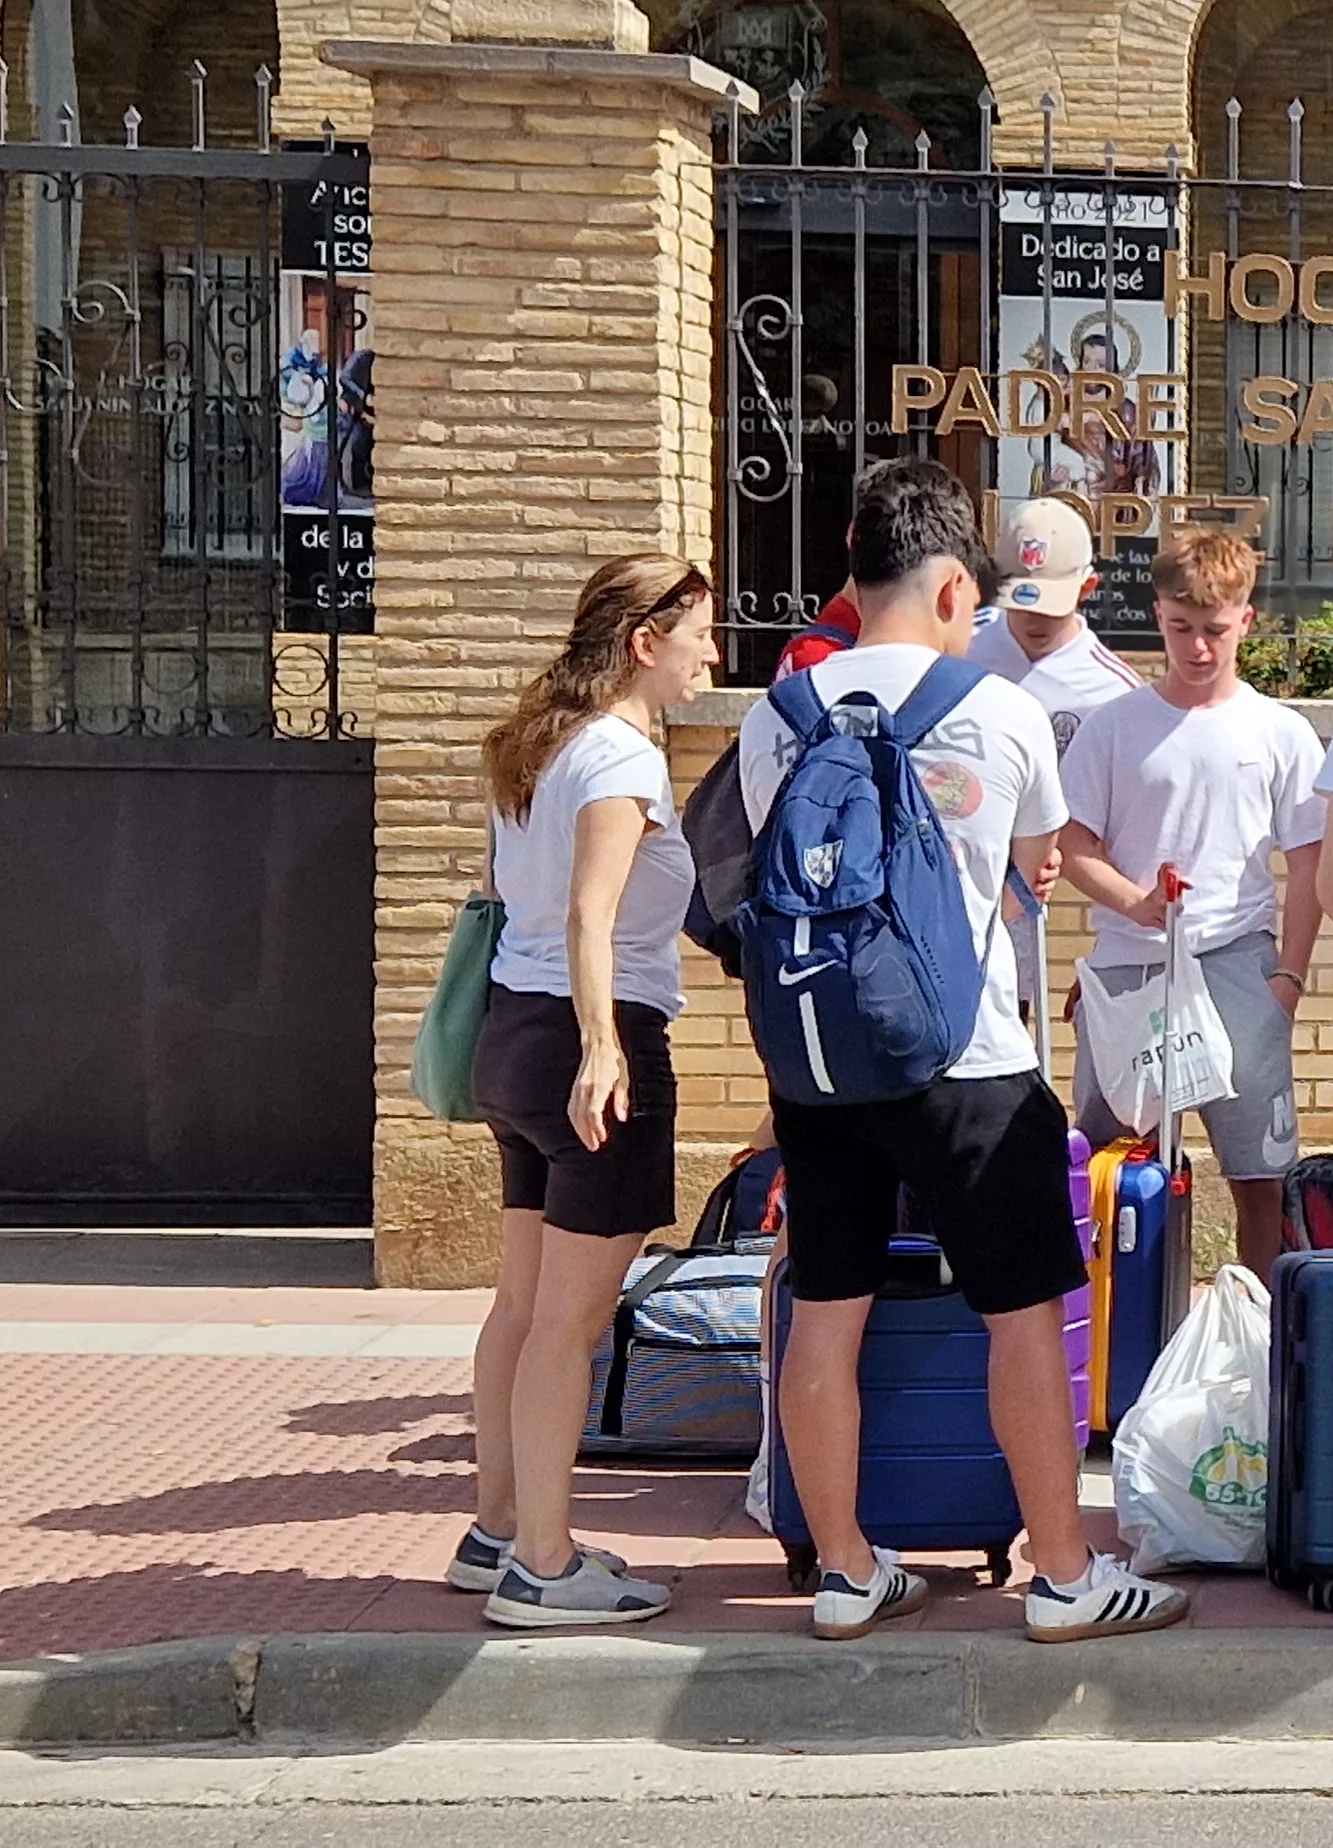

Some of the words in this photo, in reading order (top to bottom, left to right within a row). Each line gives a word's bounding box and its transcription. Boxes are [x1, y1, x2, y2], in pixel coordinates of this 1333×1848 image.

[1146, 243, 1161, 263] a
[1036, 264, 1082, 289] San
[1087, 265, 1145, 291] José
[890, 363, 1189, 441] PADRE
[342, 524, 364, 549] la
